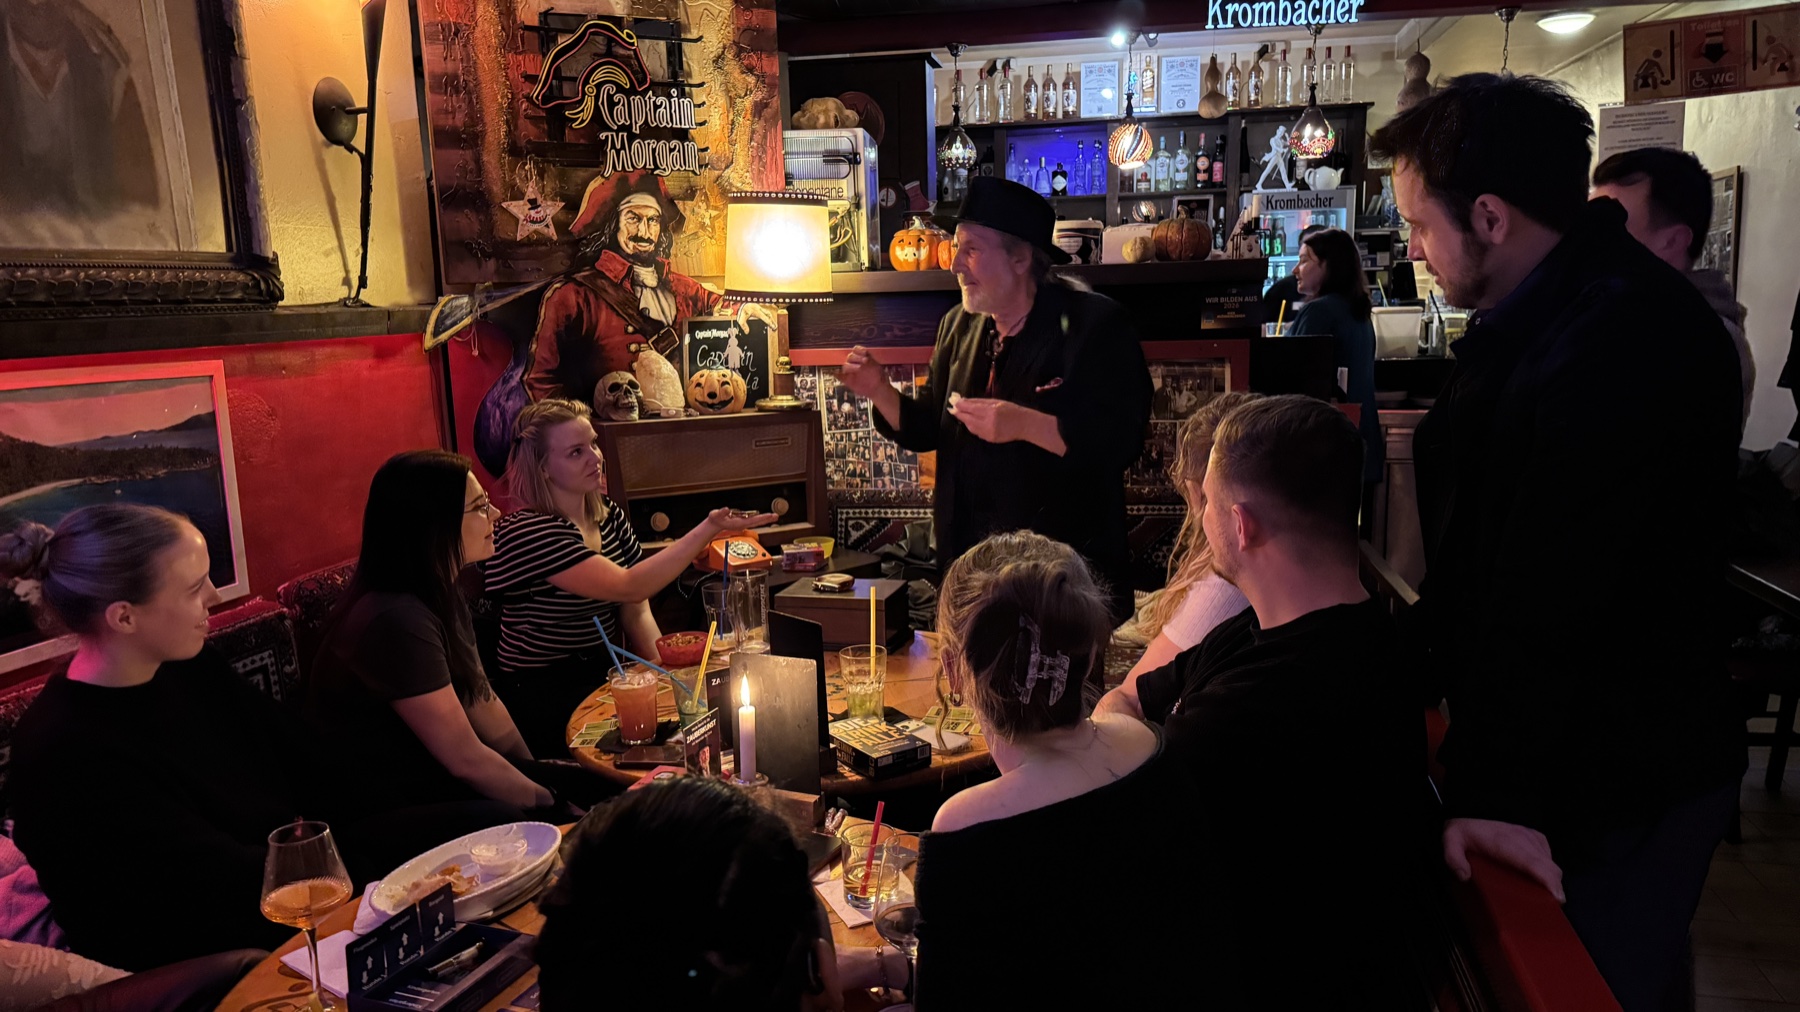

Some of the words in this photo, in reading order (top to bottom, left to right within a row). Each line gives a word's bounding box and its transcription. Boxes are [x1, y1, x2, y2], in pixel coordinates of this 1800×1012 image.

[1205, 0, 1365, 29] Krombacher
[1711, 72, 1734, 85] WC
[598, 83, 697, 133] Captain
[599, 131, 701, 178] Morgan
[1266, 194, 1334, 210] Krombacher
[695, 329, 711, 340] Captain
[834, 718, 871, 731] DIE
[836, 722, 897, 741] TRINK
[849, 730, 906, 749] FALLE
